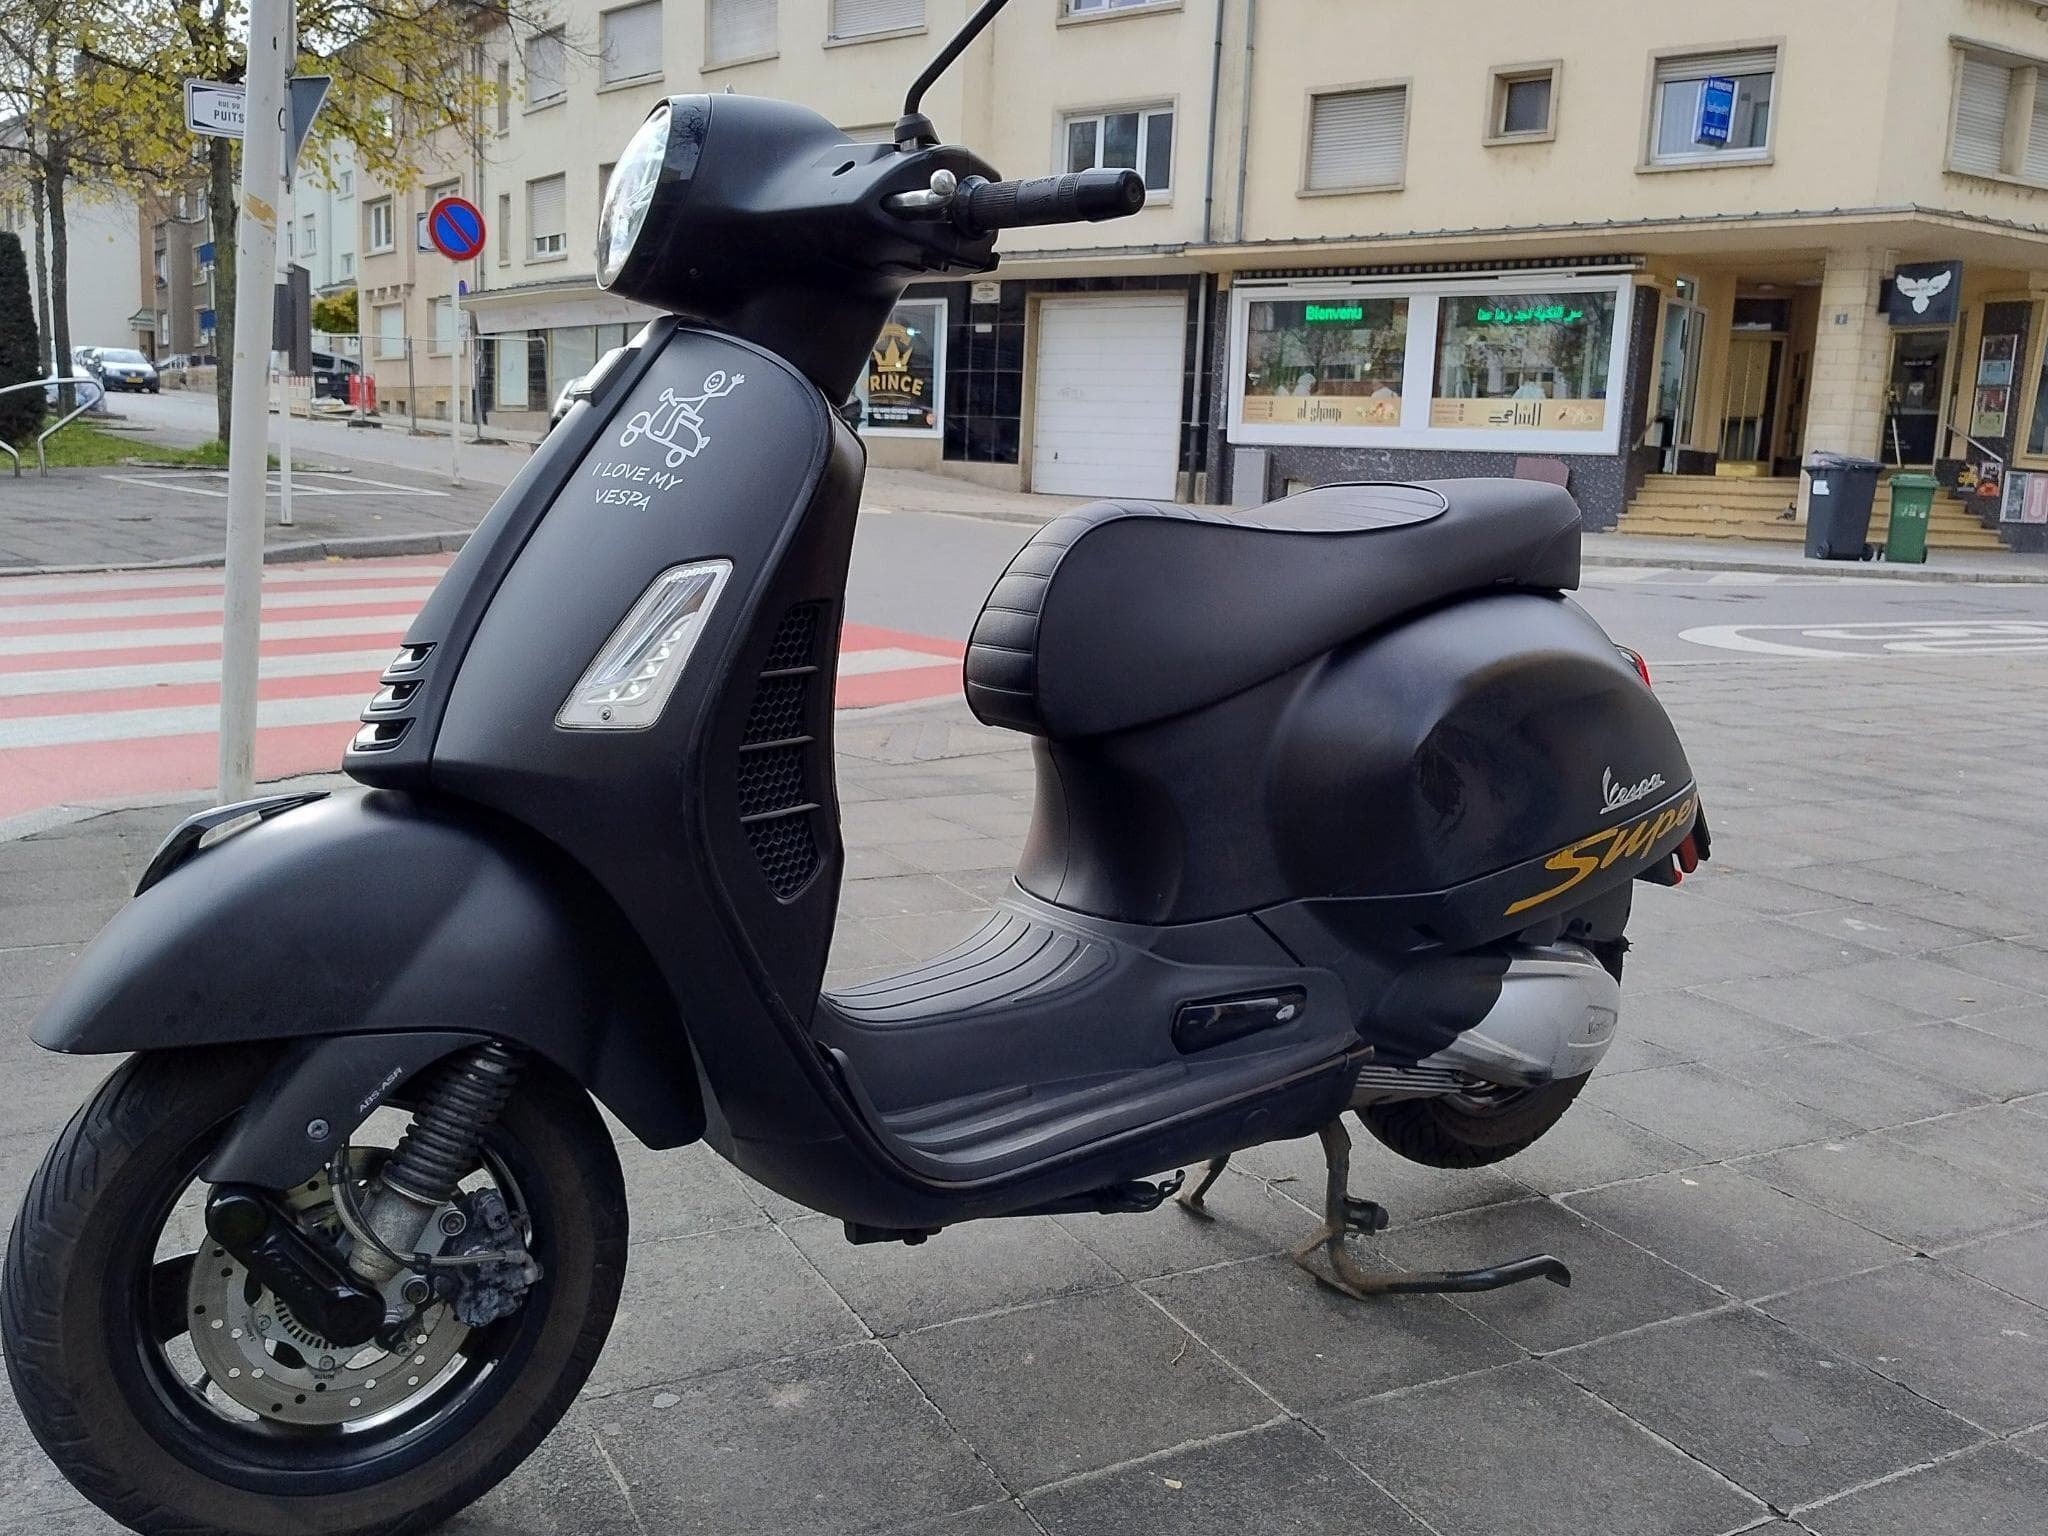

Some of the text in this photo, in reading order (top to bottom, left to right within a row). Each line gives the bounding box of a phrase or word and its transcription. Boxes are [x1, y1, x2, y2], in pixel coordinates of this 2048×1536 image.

[214, 109, 245, 124] PUITS
[592, 462, 684, 491] I LOVE MY
[595, 488, 651, 511] VESPA
[1600, 766, 1666, 815] Vespa
[360, 1067, 402, 1113] ABS-ASR
